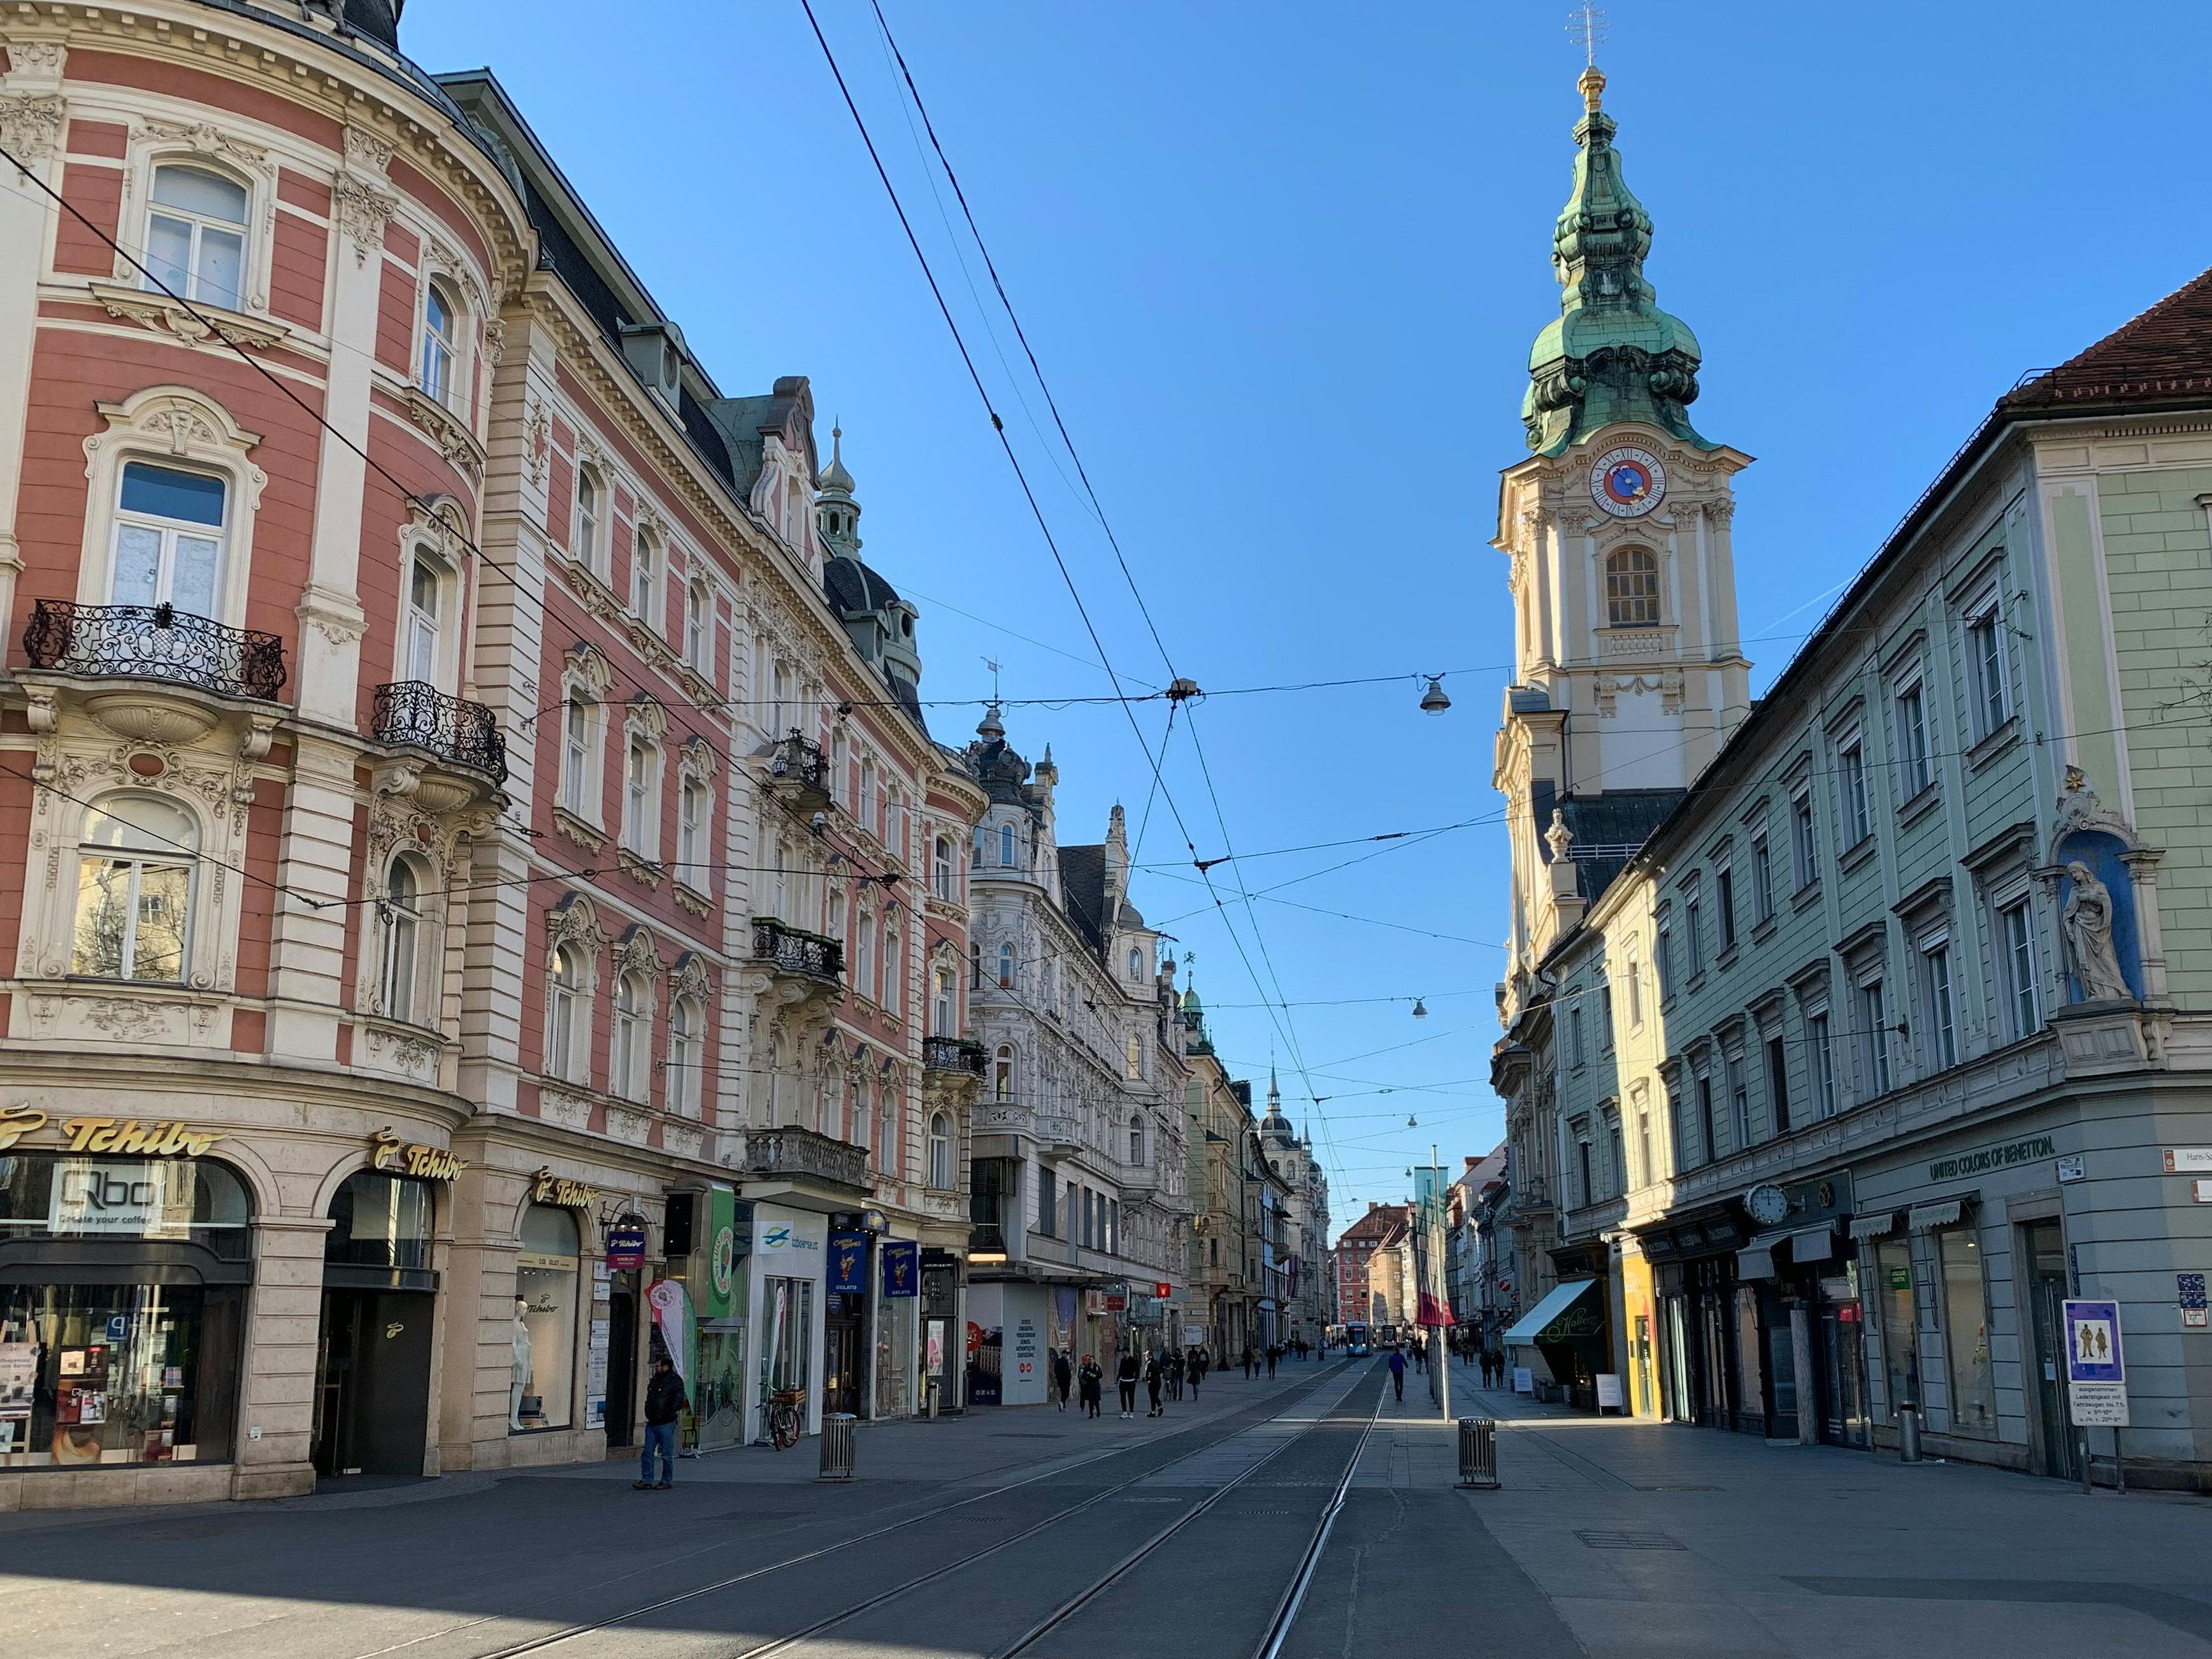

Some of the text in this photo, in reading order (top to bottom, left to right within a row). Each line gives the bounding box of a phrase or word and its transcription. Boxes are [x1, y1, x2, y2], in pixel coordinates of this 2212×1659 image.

[63, 1117, 231, 1156] Tchibo
[406, 1144, 471, 1181] Tchibo
[1930, 1160, 1958, 1181] UNITED
[1958, 1151, 1990, 1174] COLORS
[1991, 1147, 2003, 1167] OF
[62, 1170, 156, 1210] Qbo
[556, 1179, 601, 1209] Tchibo
[59, 1214, 153, 1224] Create your coffee
[528, 1305, 559, 1313] Tchibo
